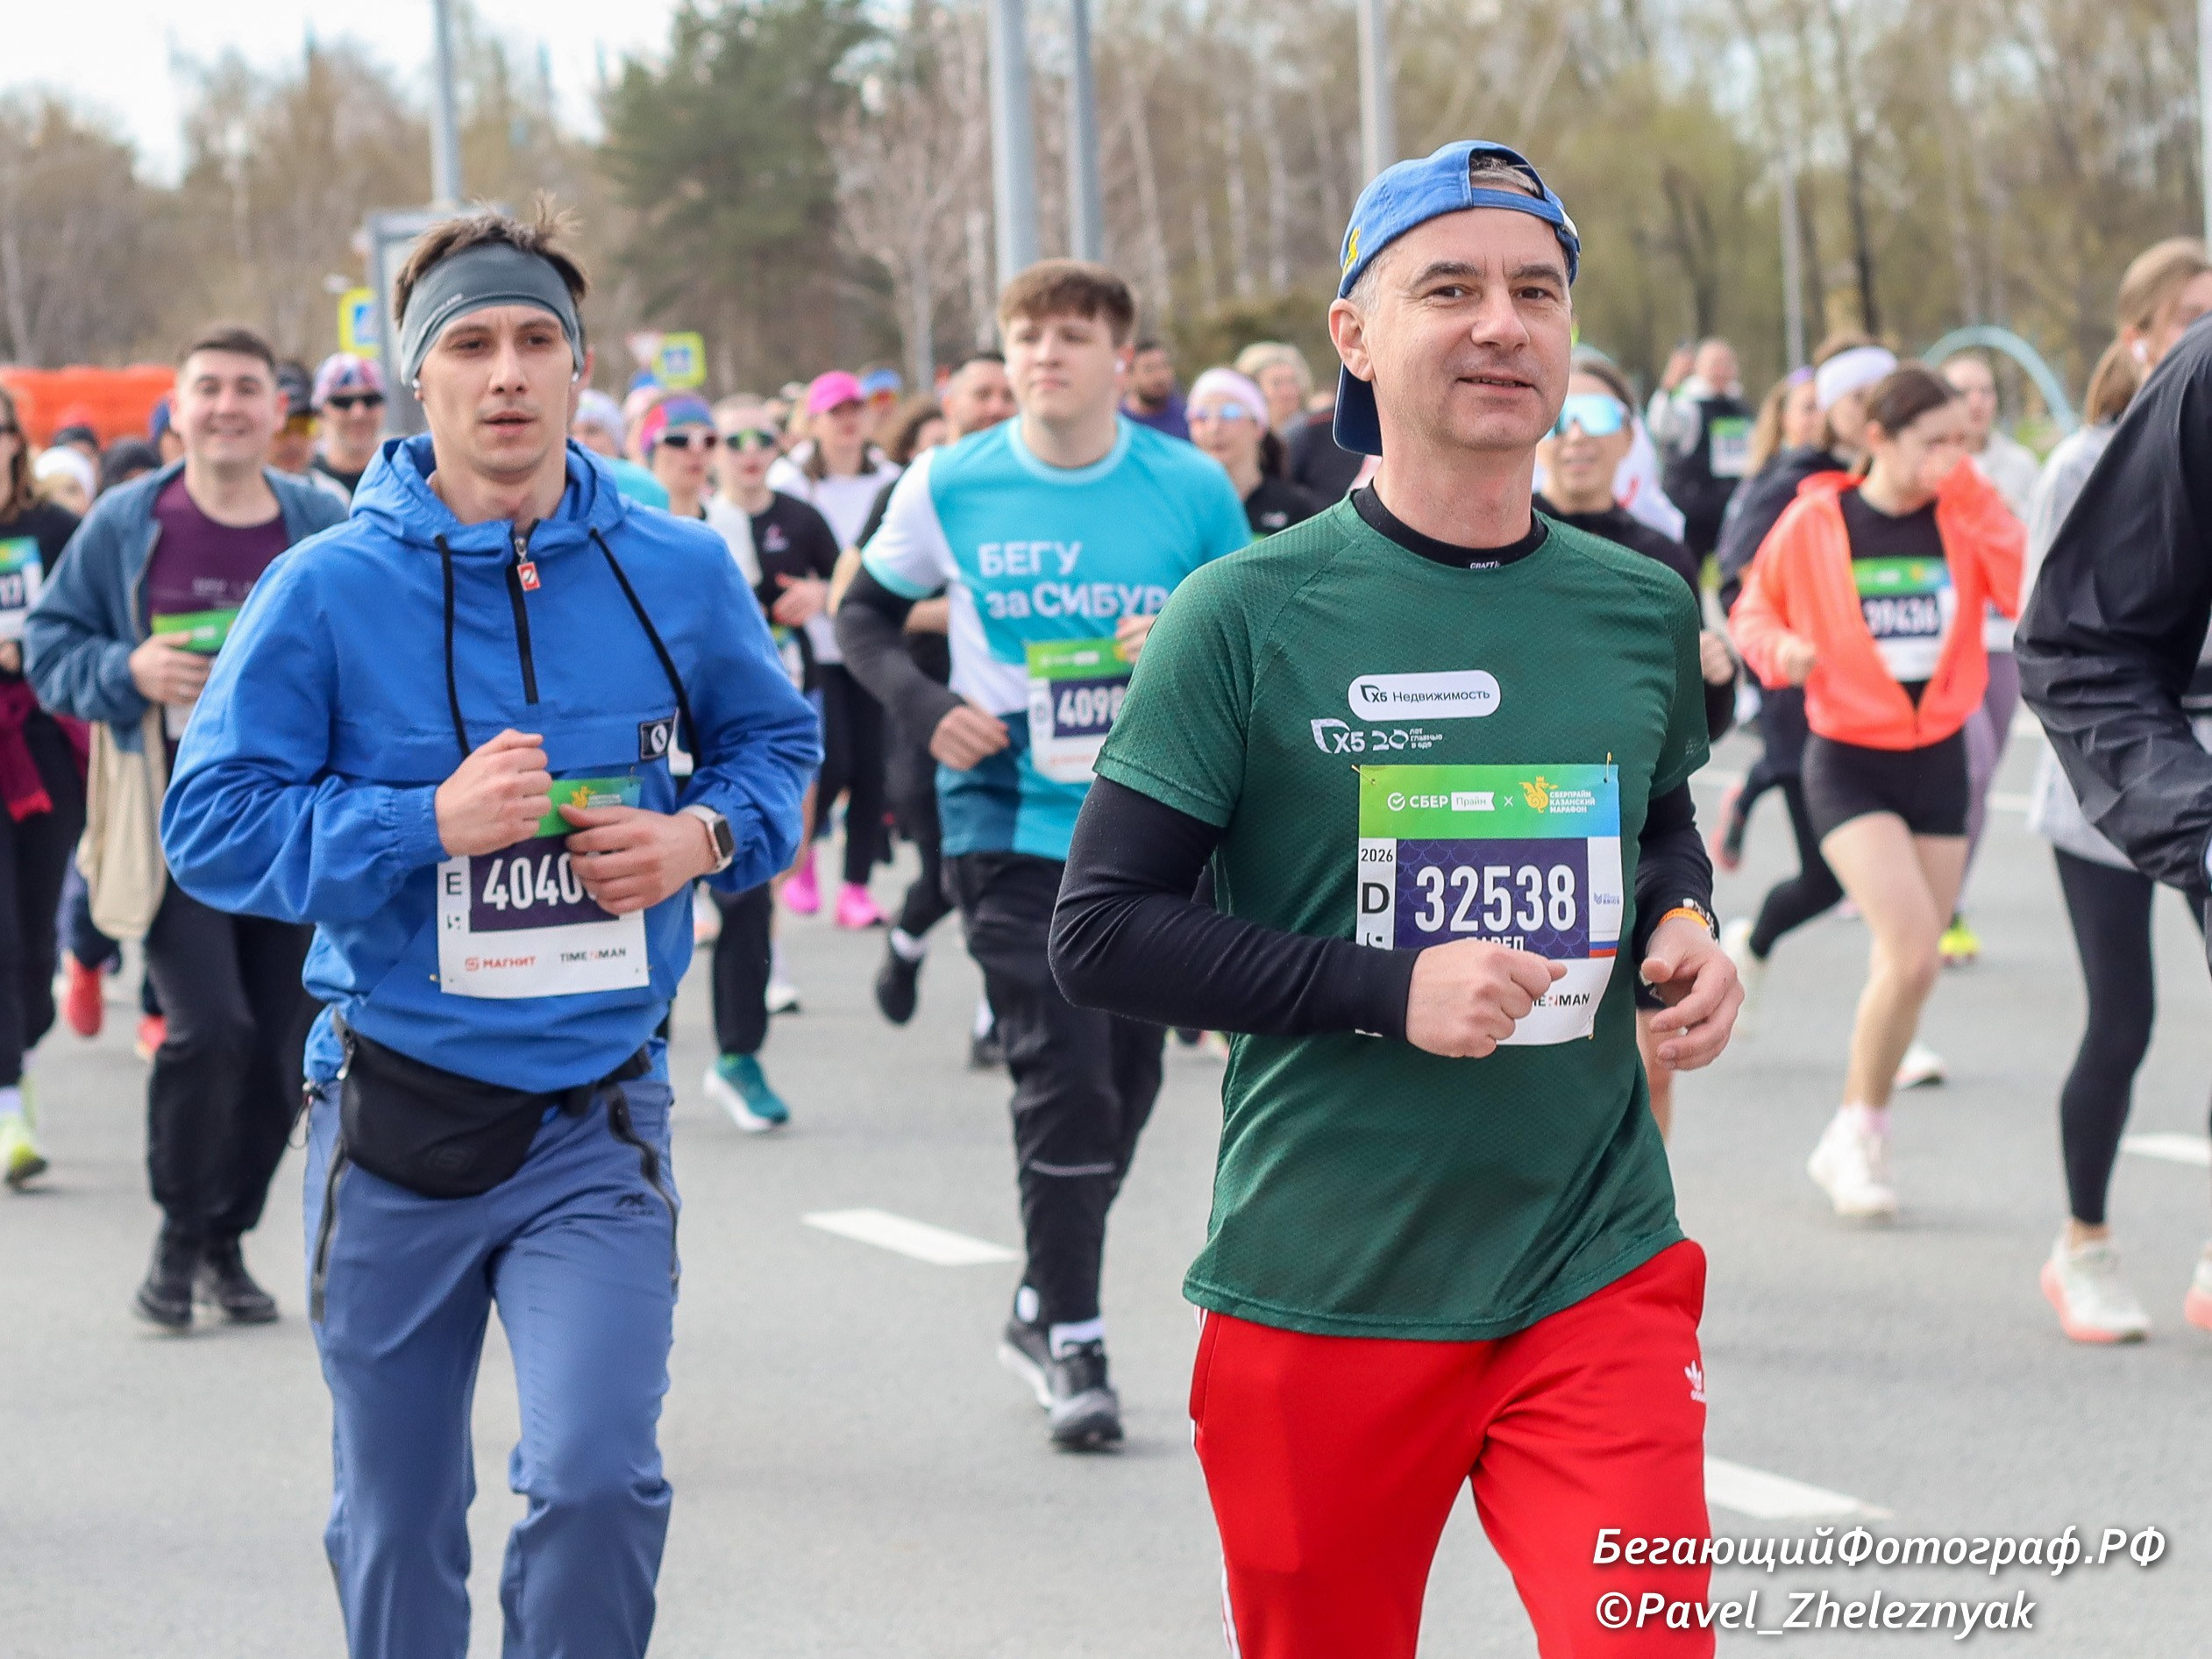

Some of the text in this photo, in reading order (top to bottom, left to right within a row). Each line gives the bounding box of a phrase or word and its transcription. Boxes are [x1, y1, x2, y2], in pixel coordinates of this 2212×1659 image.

[978, 540, 1083, 578] БЕГУ
[1393, 690, 1490, 703] Недвижимость
[1409, 795, 1448, 809] СБЕР
[1456, 796, 1487, 808] Прайм
[1549, 797, 1596, 806] КАЗАНСКИЙ
[1361, 848, 1394, 863] 2026
[446, 872, 463, 895] E
[483, 853, 599, 911] 4040
[1362, 882, 1391, 915] D
[1414, 865, 1577, 933] 32538
[482, 956, 537, 971] МАГНИТ
